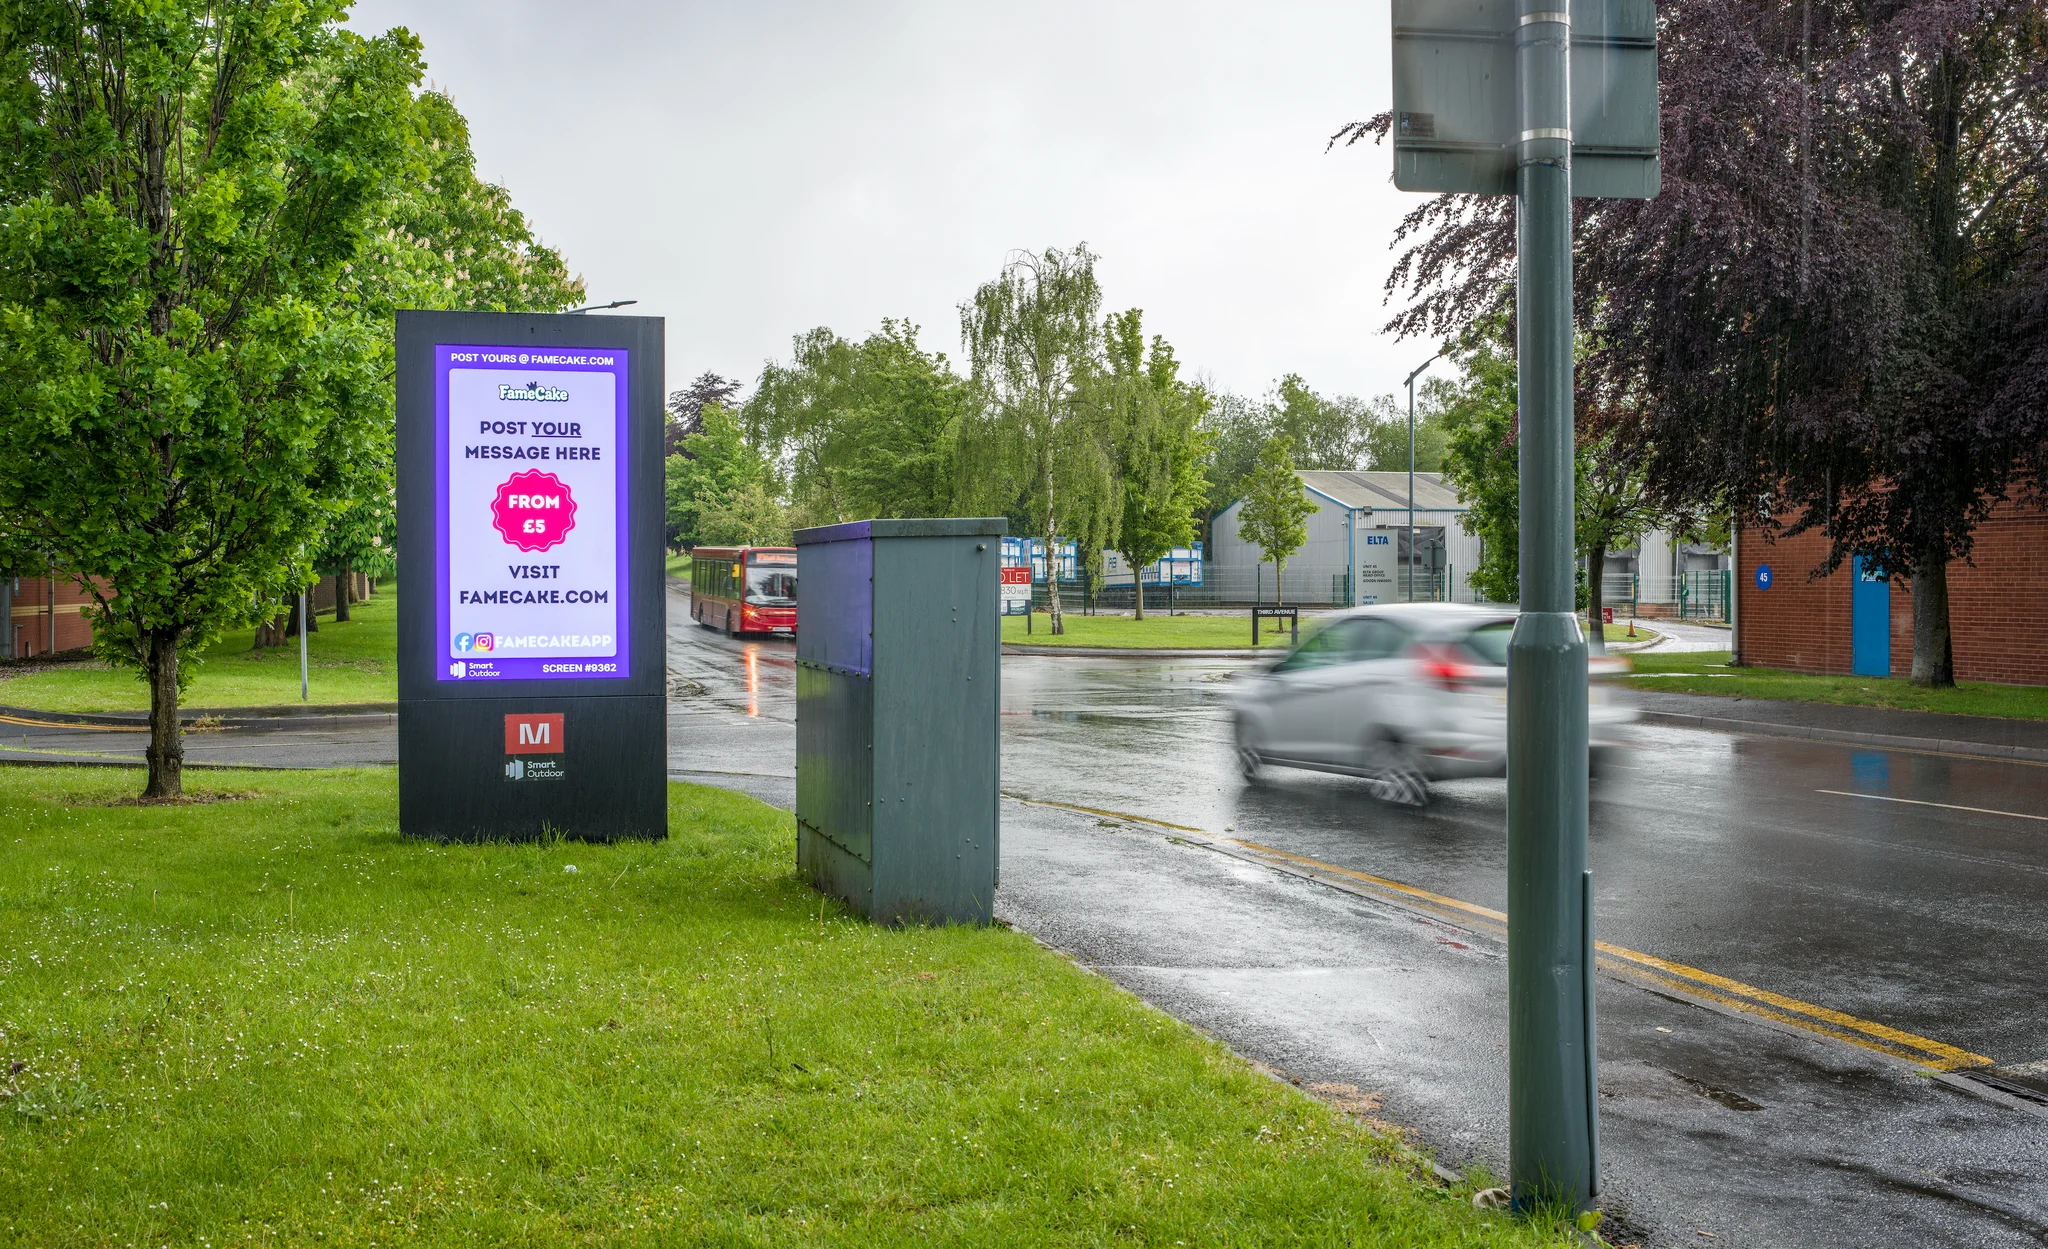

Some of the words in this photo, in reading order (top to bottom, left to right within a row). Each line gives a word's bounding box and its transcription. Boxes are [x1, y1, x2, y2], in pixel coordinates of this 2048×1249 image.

[451, 353, 479, 362] POST
[482, 354, 517, 363] YOURS
[519, 354, 530, 364] @
[531, 355, 614, 366] FAMECAKE.COM
[498, 383, 569, 402] FameCake
[480, 420, 527, 435] POST
[531, 421, 582, 437] YOUR
[465, 445, 550, 460] MESSAGE
[556, 446, 601, 461] HERE
[508, 494, 560, 509] FROM
[522, 519, 546, 533] £5
[1367, 536, 1389, 545] ELTA
[509, 565, 560, 579] VISIT
[1009, 572, 1029, 583] LET
[1760, 572, 1768, 582] 45
[460, 590, 608, 604] FAMECAKE.COM
[495, 634, 612, 648] FAMECAKEAPP
[469, 669, 501, 677] Outdoor
[542, 663, 583, 673] SCREEN
[585, 663, 617, 672] #9362
[519, 723, 550, 744] M
[527, 760, 556, 769] Smart
[527, 769, 564, 778] Outdoor
